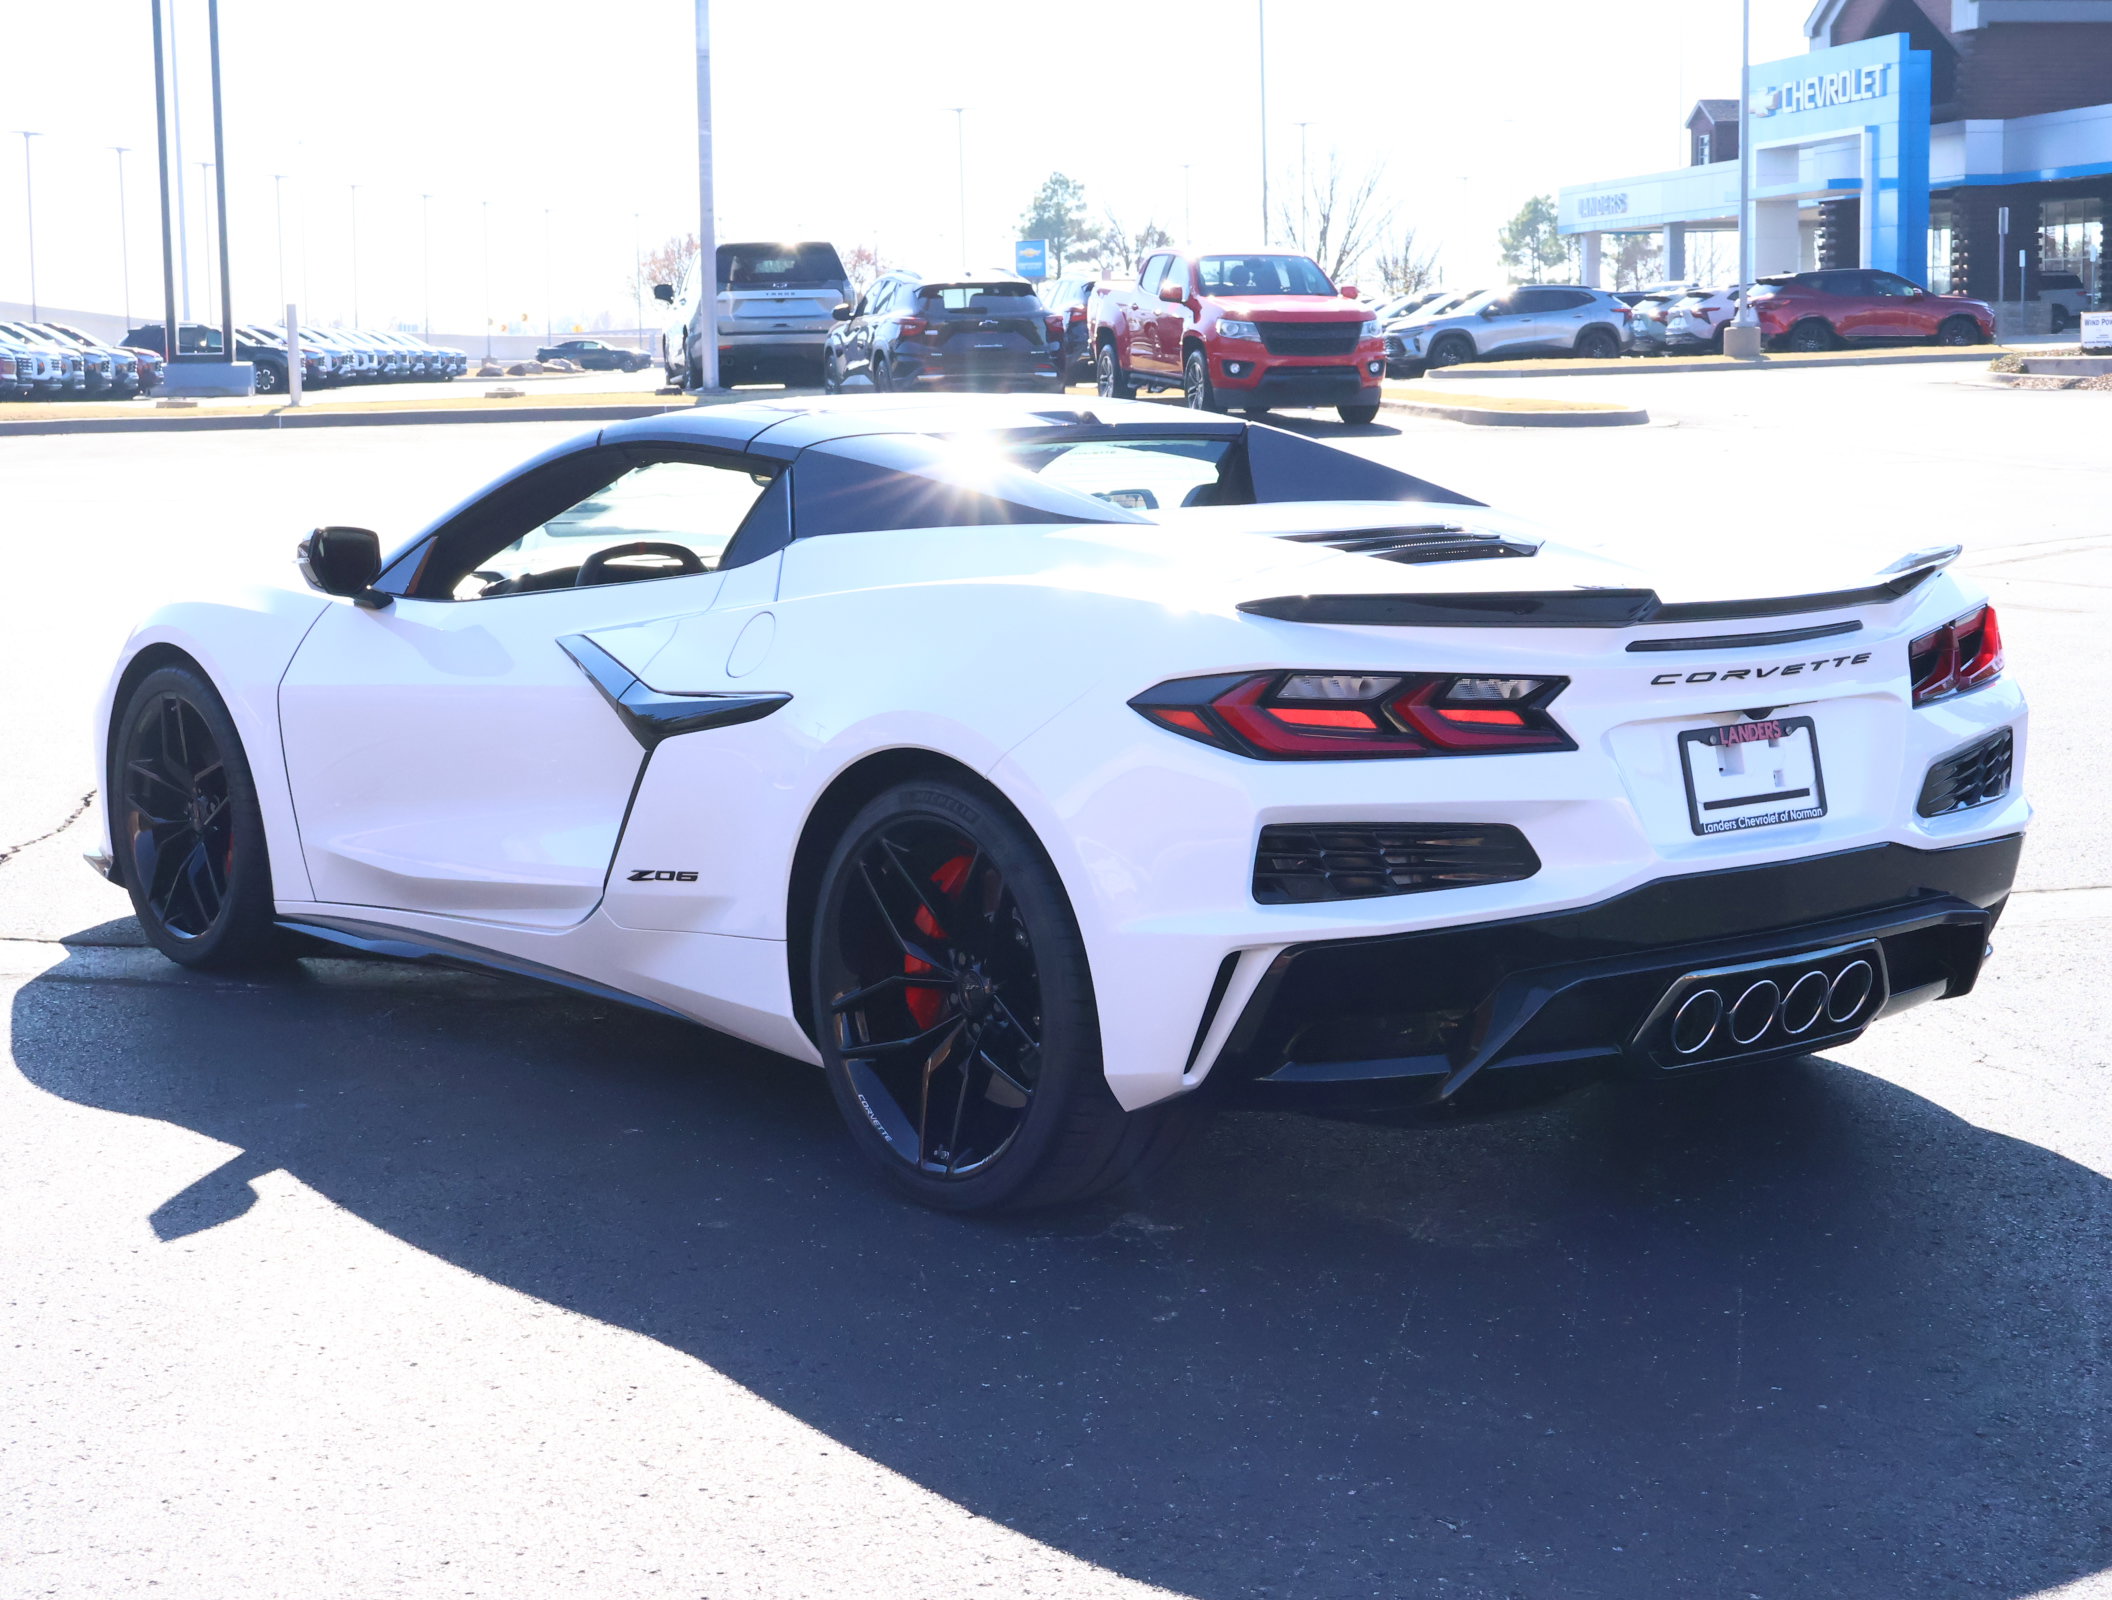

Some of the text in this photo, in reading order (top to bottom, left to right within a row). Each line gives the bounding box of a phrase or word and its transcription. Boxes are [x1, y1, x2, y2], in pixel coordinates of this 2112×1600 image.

[1781, 64, 1886, 113] CHEVROLET
[1650, 652, 1872, 685] CORVETTE
[1719, 720, 1782, 747] LANDERS
[1703, 807, 1823, 834] Landers Chevrolet of Norman
[626, 869, 699, 882] Z06
[857, 1094, 893, 1142] CORVETTE
